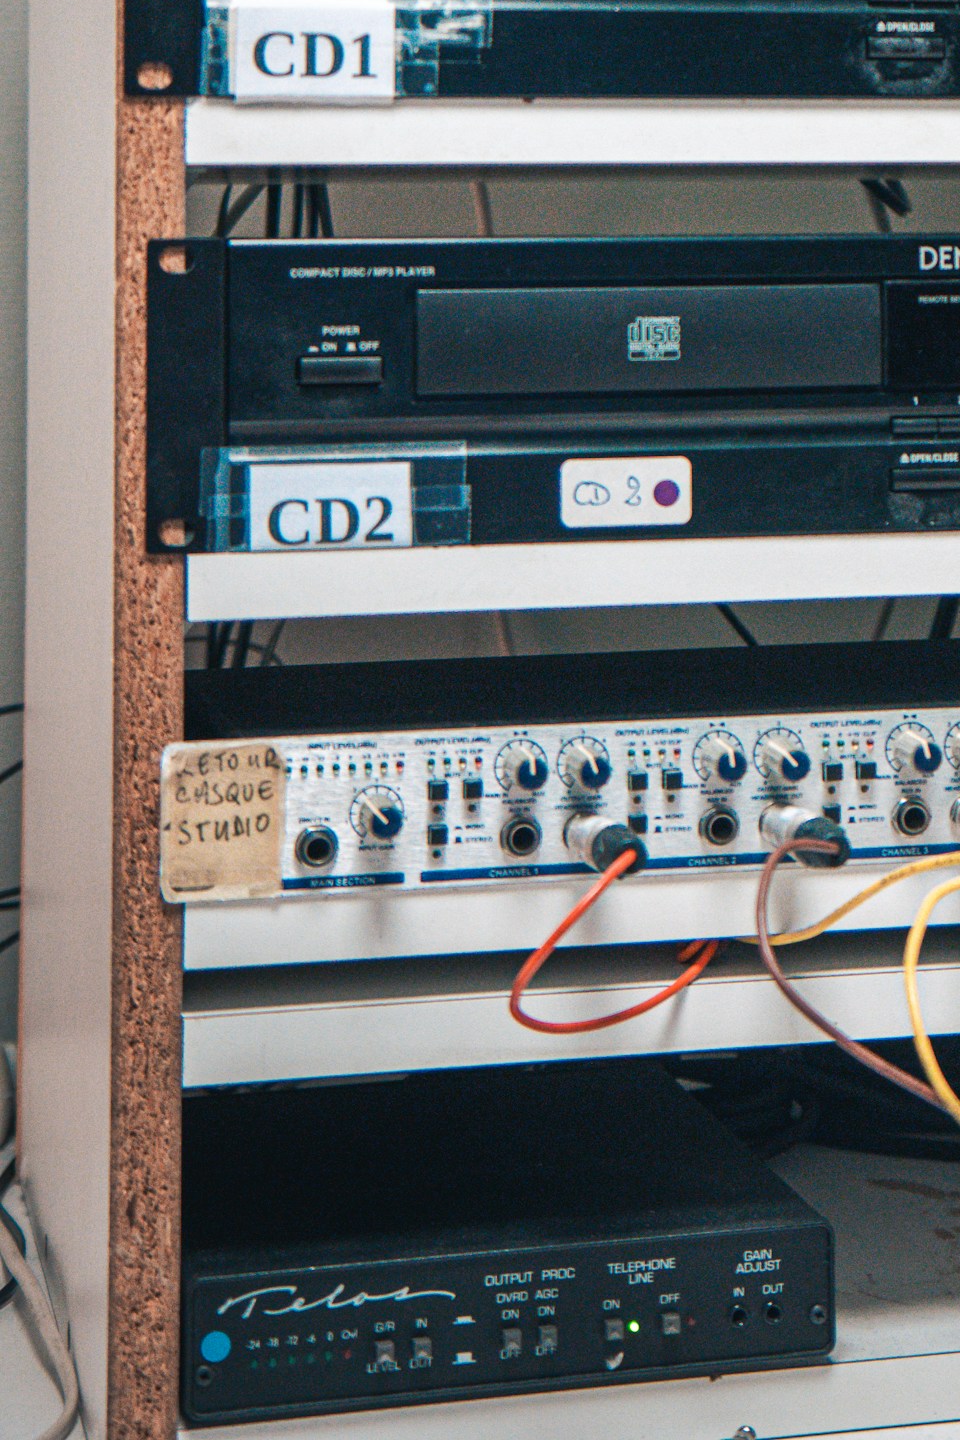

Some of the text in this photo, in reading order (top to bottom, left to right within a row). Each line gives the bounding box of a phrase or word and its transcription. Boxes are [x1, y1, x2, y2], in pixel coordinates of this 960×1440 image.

[886, 22, 935, 32] OPEN/CLOSE
[253, 31, 378, 78] CD1
[290, 268, 338, 278] COMPACT
[396, 266, 435, 276] PLAYER
[322, 325, 360, 336] POWER
[322, 341, 380, 351] ON OFF
[913, 396, 918, 405] 1
[910, 452, 959, 463] OPEN/CLOSE
[573, 481, 611, 507] CD
[268, 496, 394, 546] CD2
[175, 780, 274, 805] CASQUE
[178, 813, 270, 844] STUDIO
[882, 848, 922, 856] CHANNEL
[490, 869, 532, 877] CHANNEL
[310, 877, 375, 887] MAIN SECTION
[744, 1249, 772, 1262] GAIN
[608, 1258, 676, 1274] TELEPHONE
[736, 1260, 781, 1274] ADJUST
[485, 1268, 576, 1287] OUTPUT PROC
[628, 1272, 654, 1285] LINE
[497, 1288, 558, 1303] OVRD AGC
[733, 1282, 784, 1297] IN OUT
[603, 1299, 620, 1310] ON
[660, 1293, 680, 1305] OFF
[502, 1306, 555, 1320] ON ON
[375, 1321, 395, 1333] G/R
[416, 1318, 427, 1329] IN
[500, 1344, 556, 1359] OFF OFF
[367, 1360, 400, 1374] LEVEL
[409, 1358, 433, 1369] OUT
